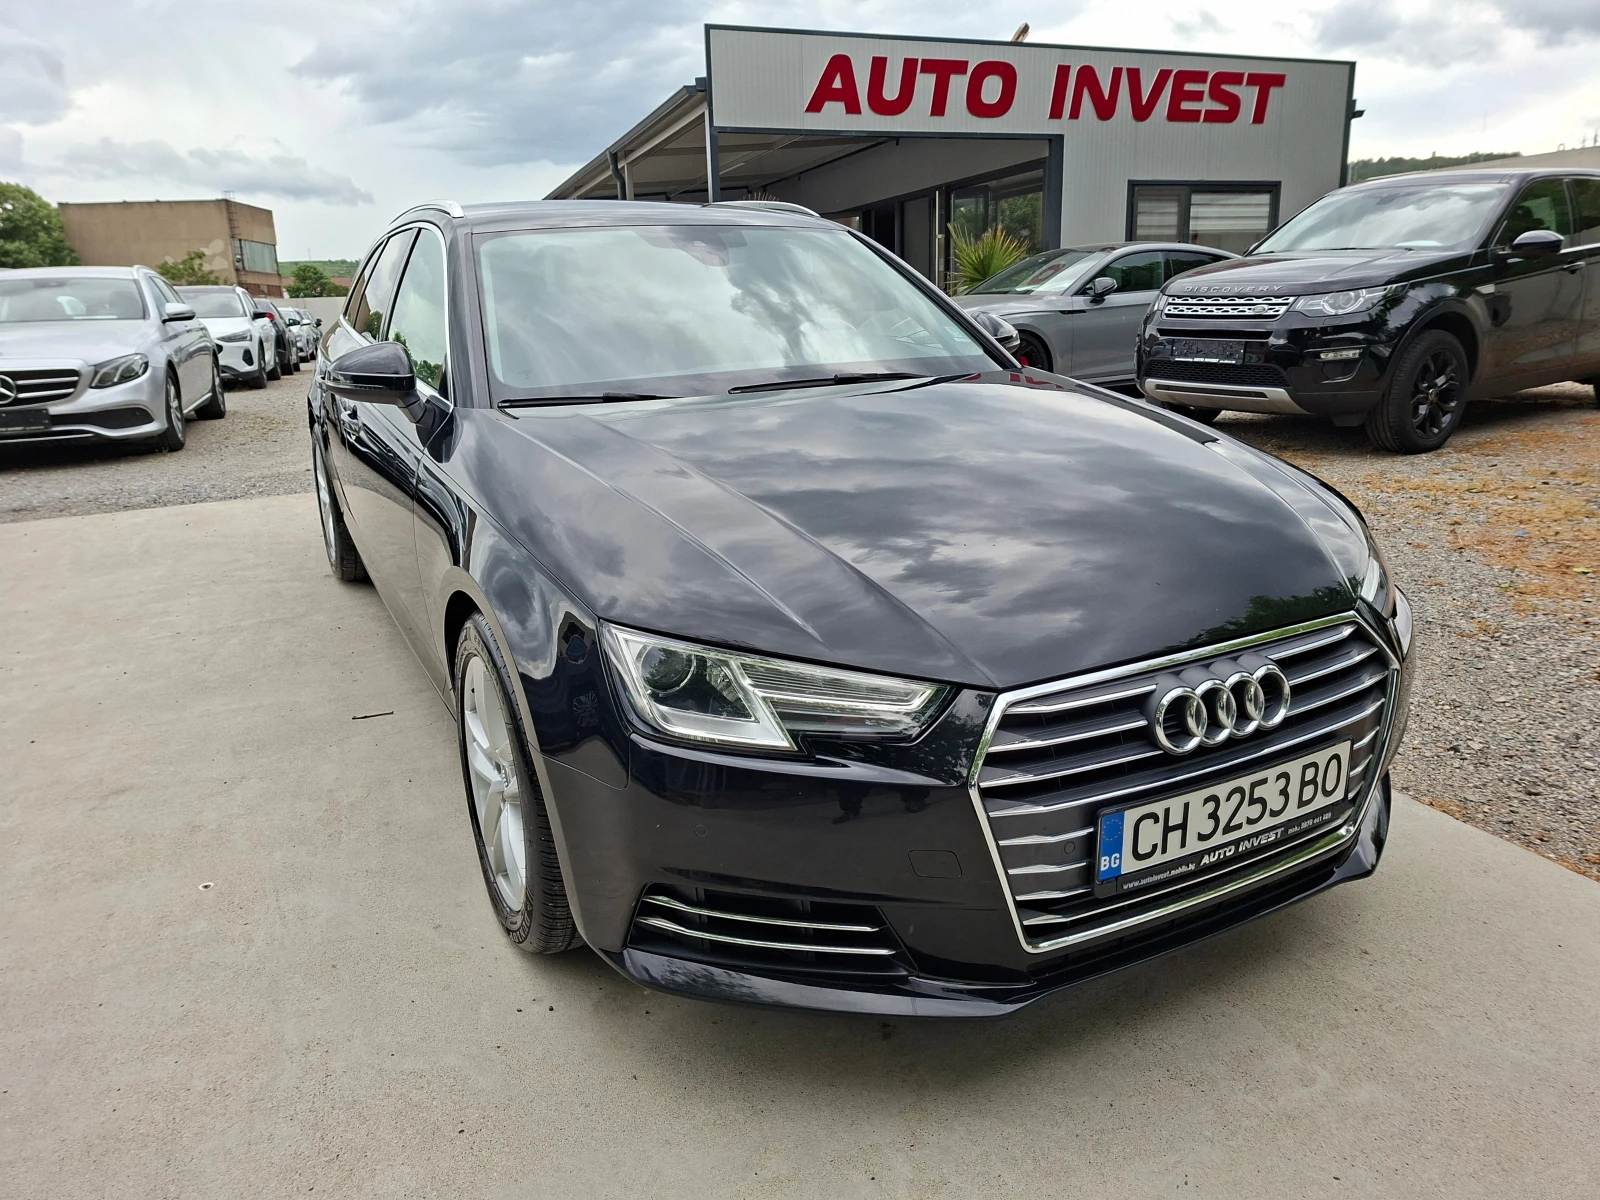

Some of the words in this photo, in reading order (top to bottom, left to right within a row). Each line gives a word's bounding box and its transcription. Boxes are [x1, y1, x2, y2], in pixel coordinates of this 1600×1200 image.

[804, 53, 1018, 119] AUTO
[1048, 63, 1287, 124] INVEST
[1184, 285, 1283, 293] DISCOVERY
[1131, 801, 1190, 862] CH
[1197, 771, 1291, 842] 3253
[1297, 753, 1342, 810] BO
[1100, 853, 1120, 871] BG
[1200, 845, 1235, 866] AUTO
[1238, 827, 1284, 852] INVEST
